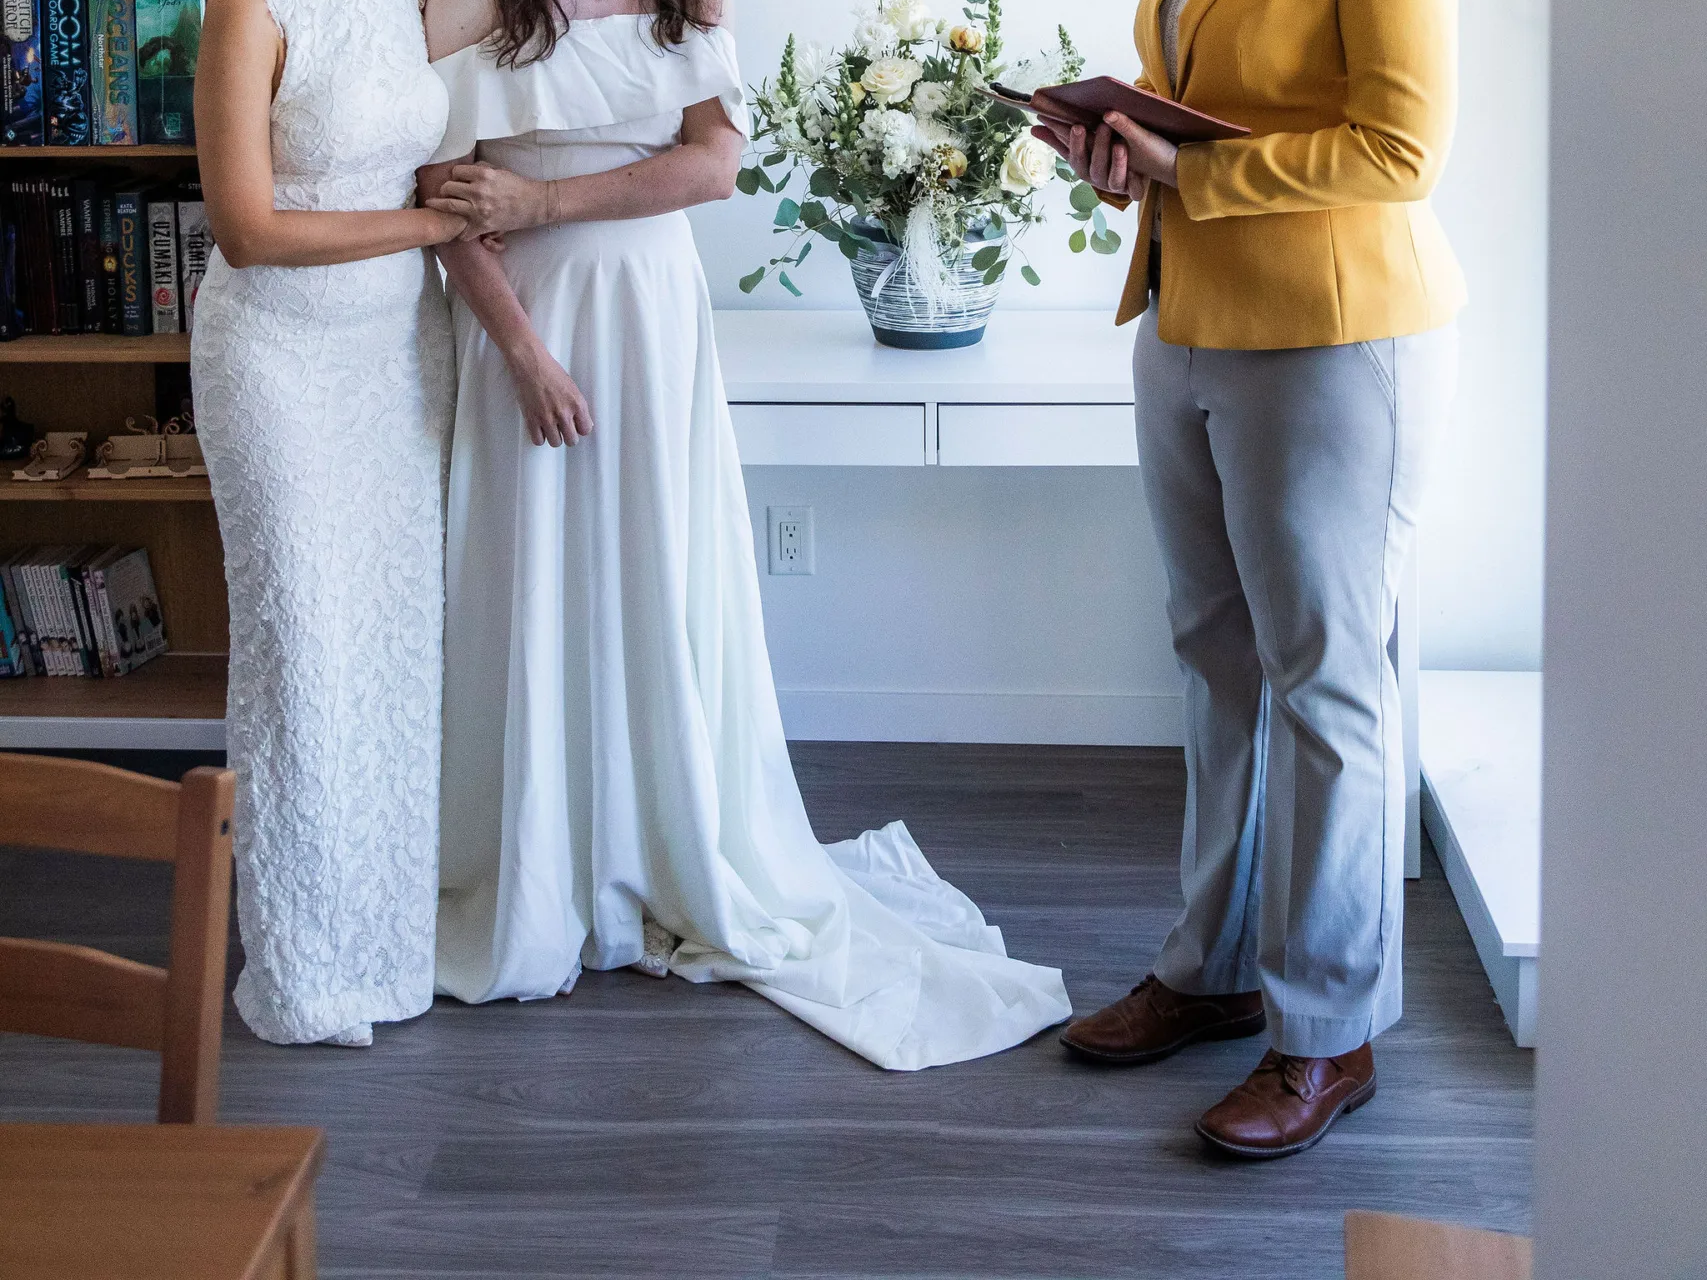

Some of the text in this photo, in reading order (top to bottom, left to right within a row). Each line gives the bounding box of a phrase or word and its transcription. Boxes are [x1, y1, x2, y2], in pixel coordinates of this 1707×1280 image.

[50, 33, 59, 66] GAME
[83, 199, 92, 234] VAMPIRE
[102, 199, 112, 233] STEPHEN
[121, 217, 137, 303] DUCKS
[153, 221, 172, 285] UZUMAKI
[188, 232, 206, 276] TOMIE
[107, 277, 117, 320] HOLLY
